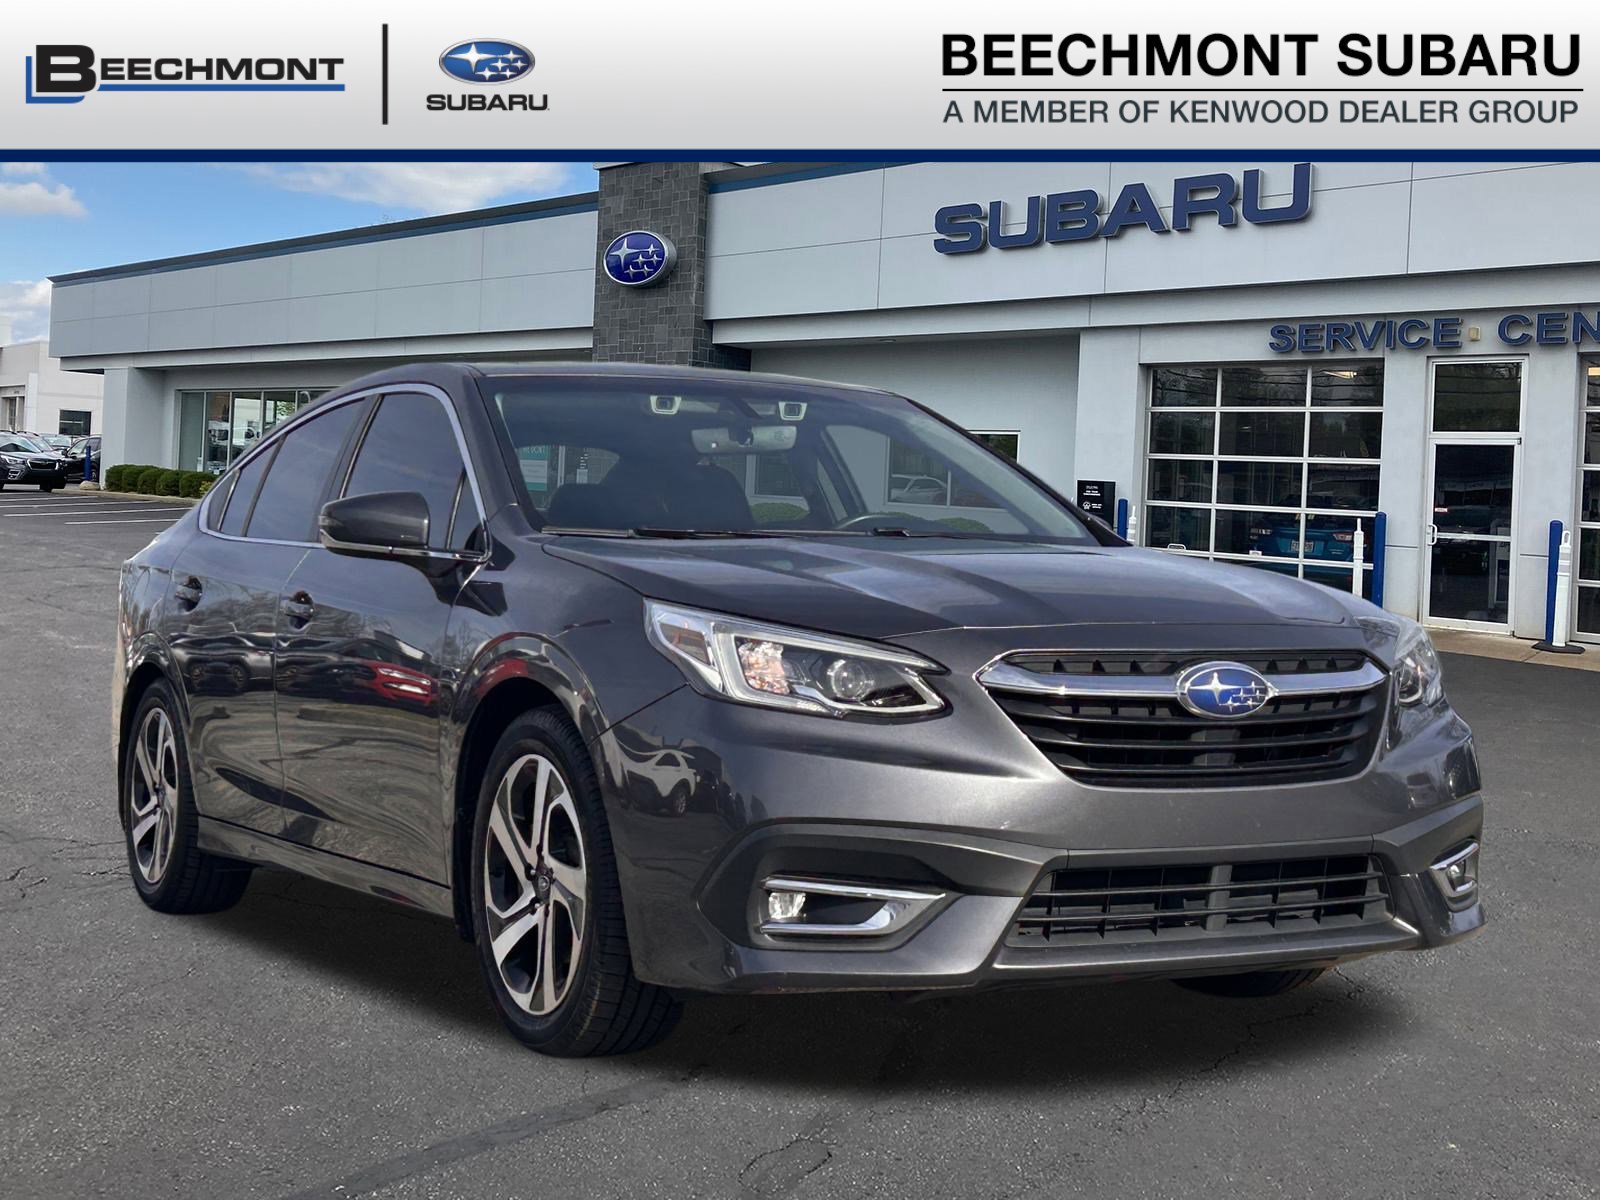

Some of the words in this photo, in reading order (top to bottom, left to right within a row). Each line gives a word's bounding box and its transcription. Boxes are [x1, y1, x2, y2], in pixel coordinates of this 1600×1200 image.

[933, 163, 1313, 254] SUBARU
[1269, 317, 1464, 353] SERVICE
[1497, 311, 1600, 346] CEN
